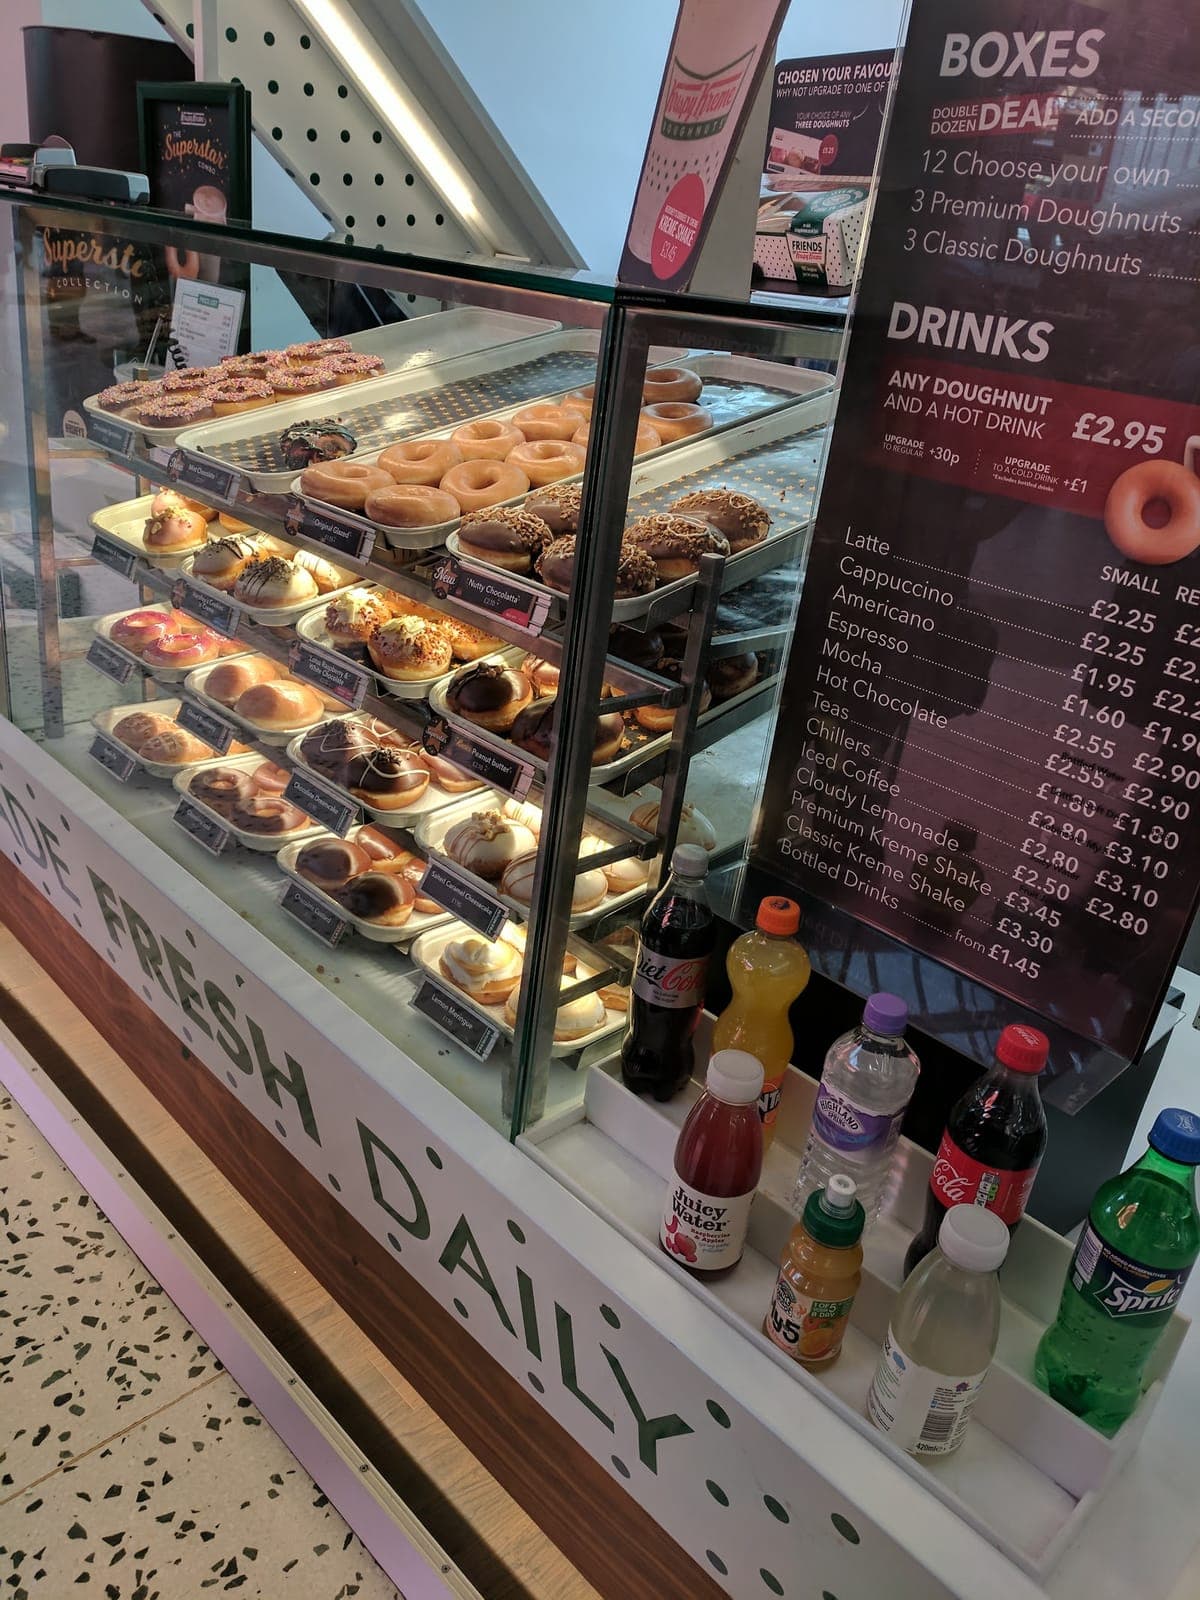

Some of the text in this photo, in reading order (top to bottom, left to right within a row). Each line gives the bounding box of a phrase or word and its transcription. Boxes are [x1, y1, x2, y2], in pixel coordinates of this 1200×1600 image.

[940, 28, 1106, 79] BOXES
[776, 81, 886, 99] WHY NOT UPGRADE TO ONE OF
[777, 67, 819, 85] CHOSEN
[822, 65, 852, 82] YOUR
[795, 119, 850, 129] THREE DOUGHNUTS
[931, 119, 977, 135] DOZEN
[932, 105, 979, 120] DOUBLE
[1075, 109, 1118, 126] ADD
[1121, 109, 1136, 126] A
[165, 133, 225, 170] Superstar
[922, 149, 1171, 189] 12 Choose your own
[911, 189, 1182, 235] 3 Premium Doughnuts
[792, 240, 823, 252] FRIENDS
[903, 228, 1143, 275] 3 Classic Doughnuts
[56, 277, 144, 306] COLLECTION
[887, 301, 1055, 363] DRINKS
[888, 370, 1053, 416] ANY DOUGHNUT
[883, 393, 1047, 440] AND A HOT DRINK
[1071, 412, 1168, 454] £2.95
[882, 441, 924, 458] TO REGULAR
[884, 434, 925, 450] UPGRADE
[929, 446, 960, 466] +30p
[992, 463, 1060, 485] TO A COLD DRINK
[1004, 456, 1051, 474] UPGRADE
[1063, 478, 1088, 494] +£1
[845, 526, 890, 556] Latte
[434, 567, 456, 586] New
[839, 556, 954, 607] Cappuccino
[1100, 565, 1161, 595] SMALL
[832, 584, 936, 632] Americano
[1089, 599, 1157, 634] £2.25
[827, 611, 909, 654] Espresso
[1079, 631, 1147, 666] £2.25
[822, 638, 882, 675] Mocha
[816, 664, 948, 729] Hot Chocolate
[1070, 663, 1137, 698] £1.95
[811, 690, 850, 720] Teas
[806, 717, 872, 757] Chillers
[1062, 694, 1200, 758] £1.60 £1.9
[471, 748, 492, 764] Peanut
[801, 741, 901, 797] Iced Coffee
[1053, 724, 1200, 790] £2.55 £2.90
[1044, 753, 1190, 821] £2.55 £2.90
[796, 767, 960, 852] Cloudy Lemonade
[1036, 782, 1179, 851] £1.80 £1.80
[791, 789, 993, 897] Premium Kreme Shake
[1028, 810, 1169, 880] £2.80 £3.10
[780, 838, 900, 910] Bottled Drinks
[786, 814, 967, 913] Classic Kreme Shake
[1020, 838, 1159, 908] £2.80 £3.10
[431, 870, 446, 885] Salted
[445, 880, 466, 897] Caramel
[464, 893, 493, 916] Cheesecake
[1004, 891, 1063, 928] £3.45
[1012, 864, 1149, 937] £2.50 £2.80
[955, 929, 1041, 979] from £1.45
[996, 917, 1054, 954] £3.30
[431, 992, 449, 1010] Lemon
[448, 1006, 473, 1030] Meringue
[820, 1099, 859, 1131] HIGHLAND
[827, 1112, 847, 1128] SPRING
[86, 864, 322, 1149] FRESH
[356, 1116, 696, 1477] DAILY
[933, 1159, 975, 1201] Cola
[672, 1195, 729, 1232] Water
[675, 1186, 728, 1221] Juicy
[690, 1228, 731, 1238] Raspberries
